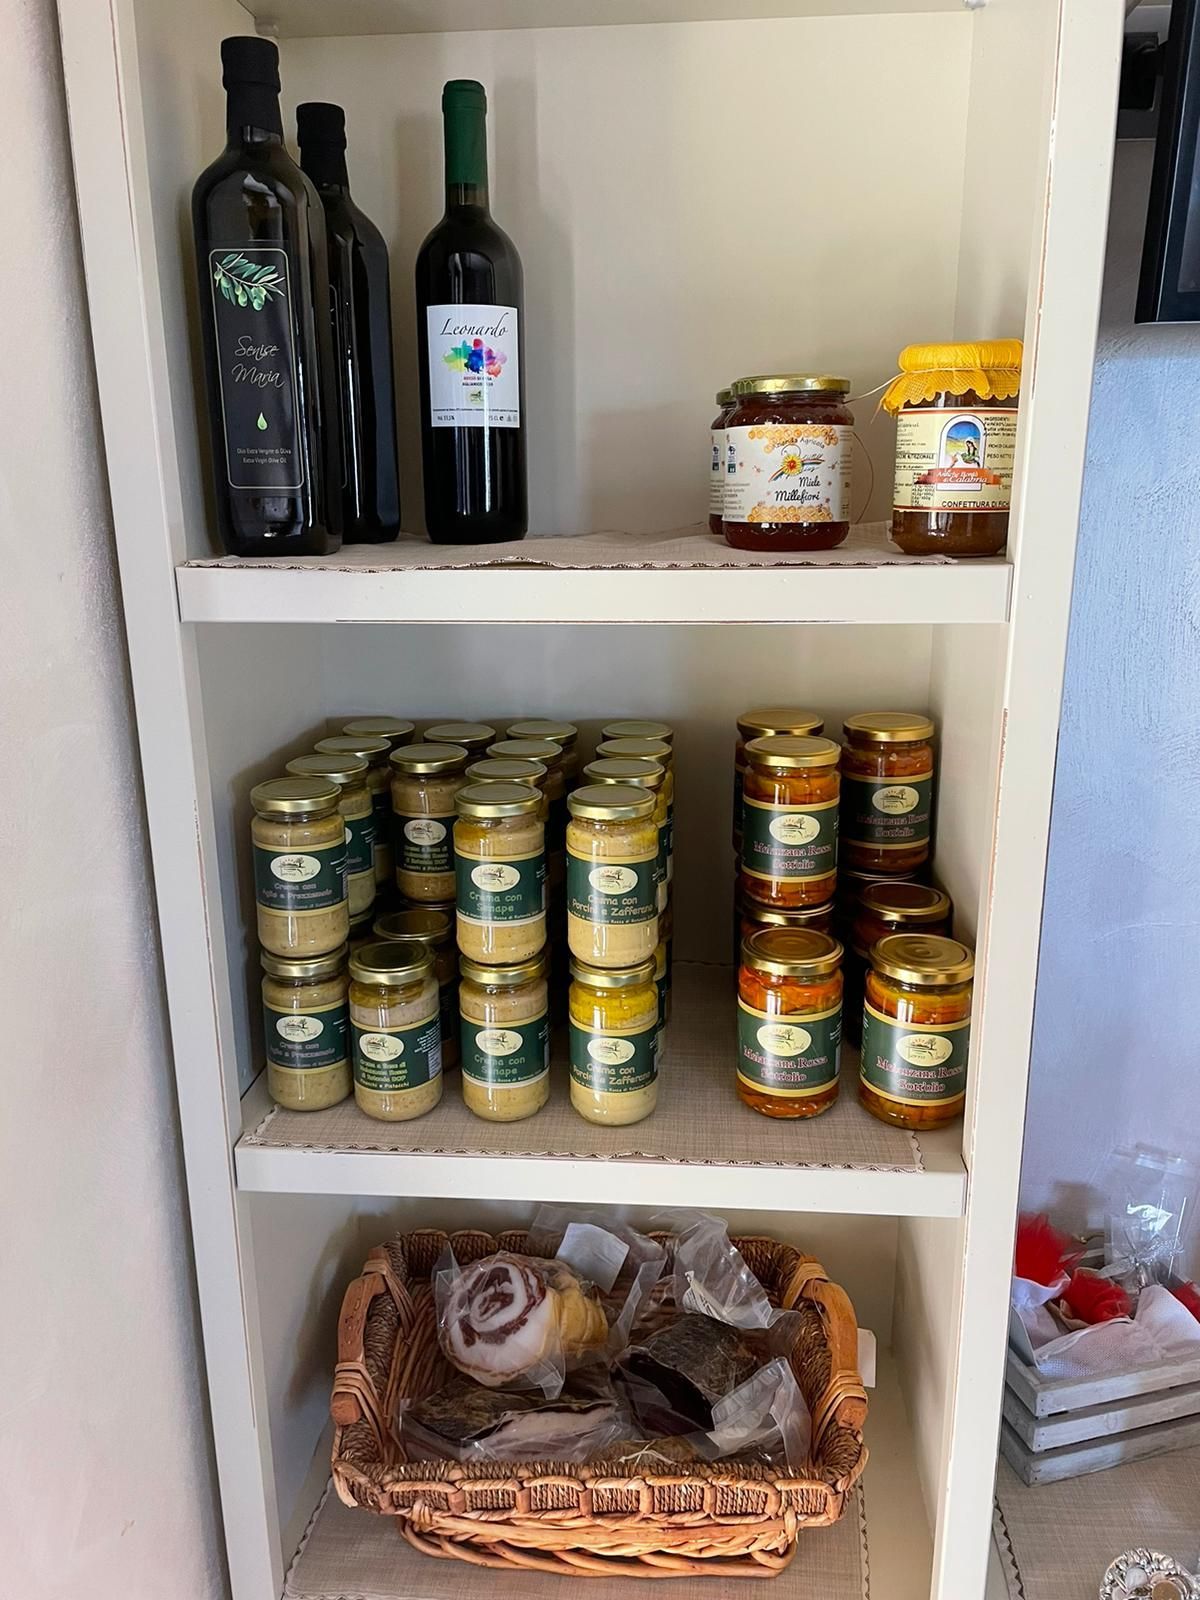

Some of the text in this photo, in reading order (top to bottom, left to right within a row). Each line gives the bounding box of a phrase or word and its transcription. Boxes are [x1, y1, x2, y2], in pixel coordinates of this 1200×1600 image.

[440, 312, 508, 337] Leonardo
[234, 335, 280, 361] Senise
[231, 363, 285, 388] Maria
[800, 437, 825, 449] Agricola
[258, 448, 274, 456] Vergine
[255, 457, 267, 465] Virgin
[799, 476, 821, 487] Miele
[775, 490, 820, 504] Millefiori
[469, 891, 500, 902] Crma
[588, 895, 638, 905] Cema con
[477, 903, 514, 915] Snape
[572, 899, 598, 913] Porcin
[611, 904, 653, 916] Zafferano
[508, 1056, 525, 1065] con
[743, 1045, 796, 1069] Melanzana
[797, 1056, 828, 1068] Rossa
[481, 1065, 517, 1077] Snape
[587, 1063, 635, 1075] Cema con
[876, 1056, 937, 1078] Melanzana
[573, 1065, 596, 1081] Porcin
[609, 1071, 651, 1085] Zafferano
